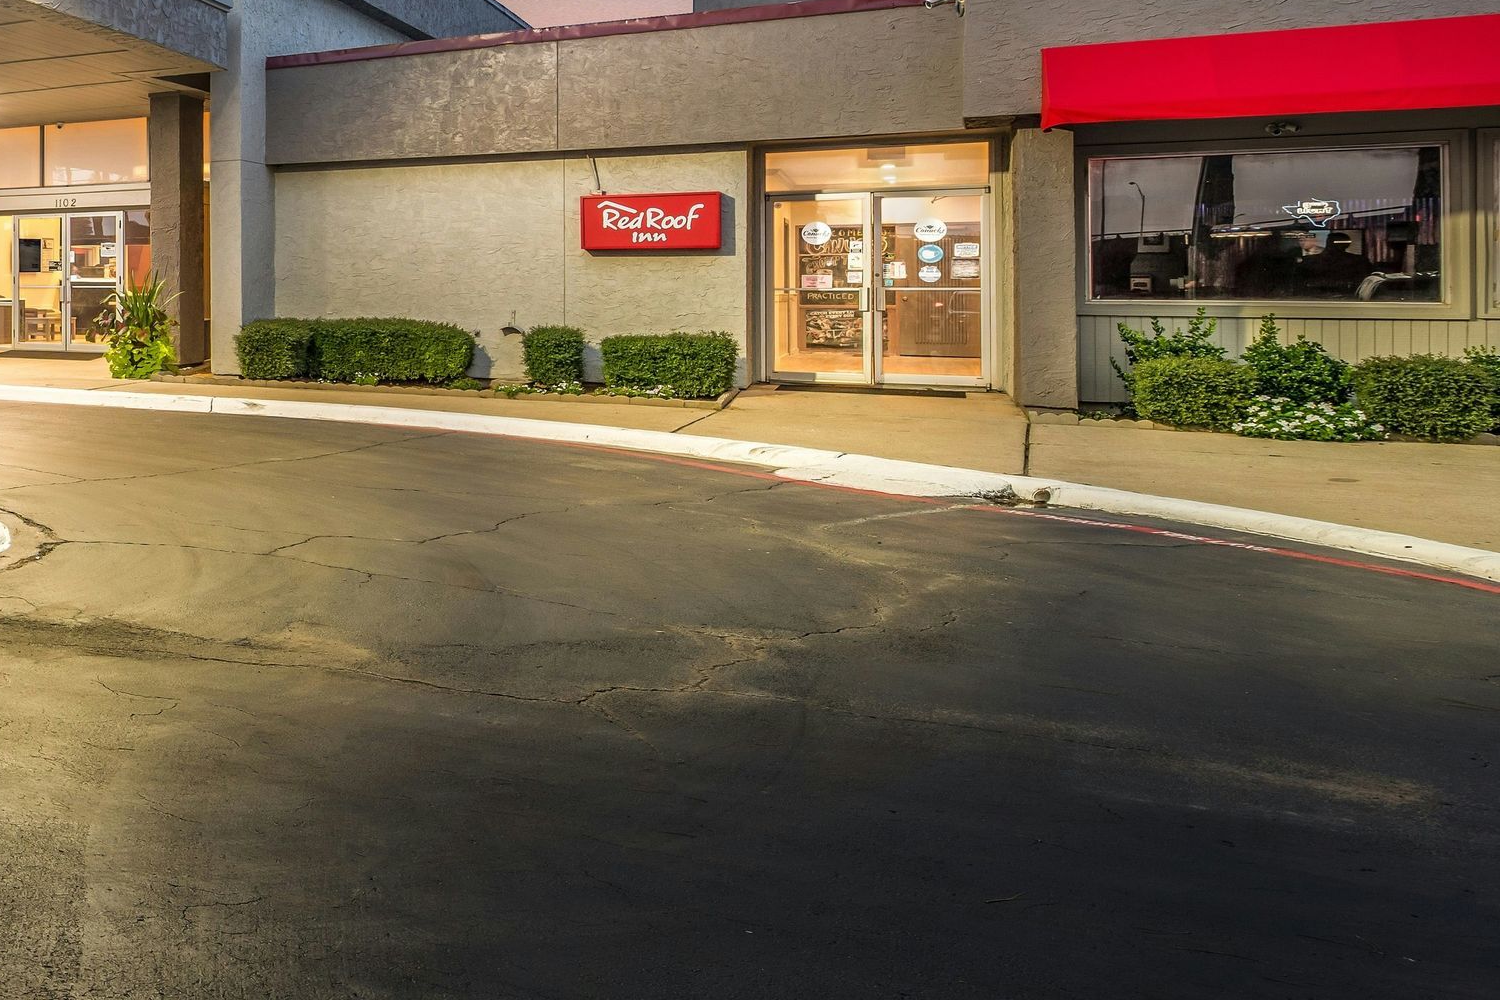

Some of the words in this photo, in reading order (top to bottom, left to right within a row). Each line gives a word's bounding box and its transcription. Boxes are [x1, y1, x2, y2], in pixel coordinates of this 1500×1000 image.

[55, 198, 77, 207] 1102
[602, 208, 644, 231] Red
[646, 203, 705, 230] Roof
[807, 292, 855, 300] PRACTICED
